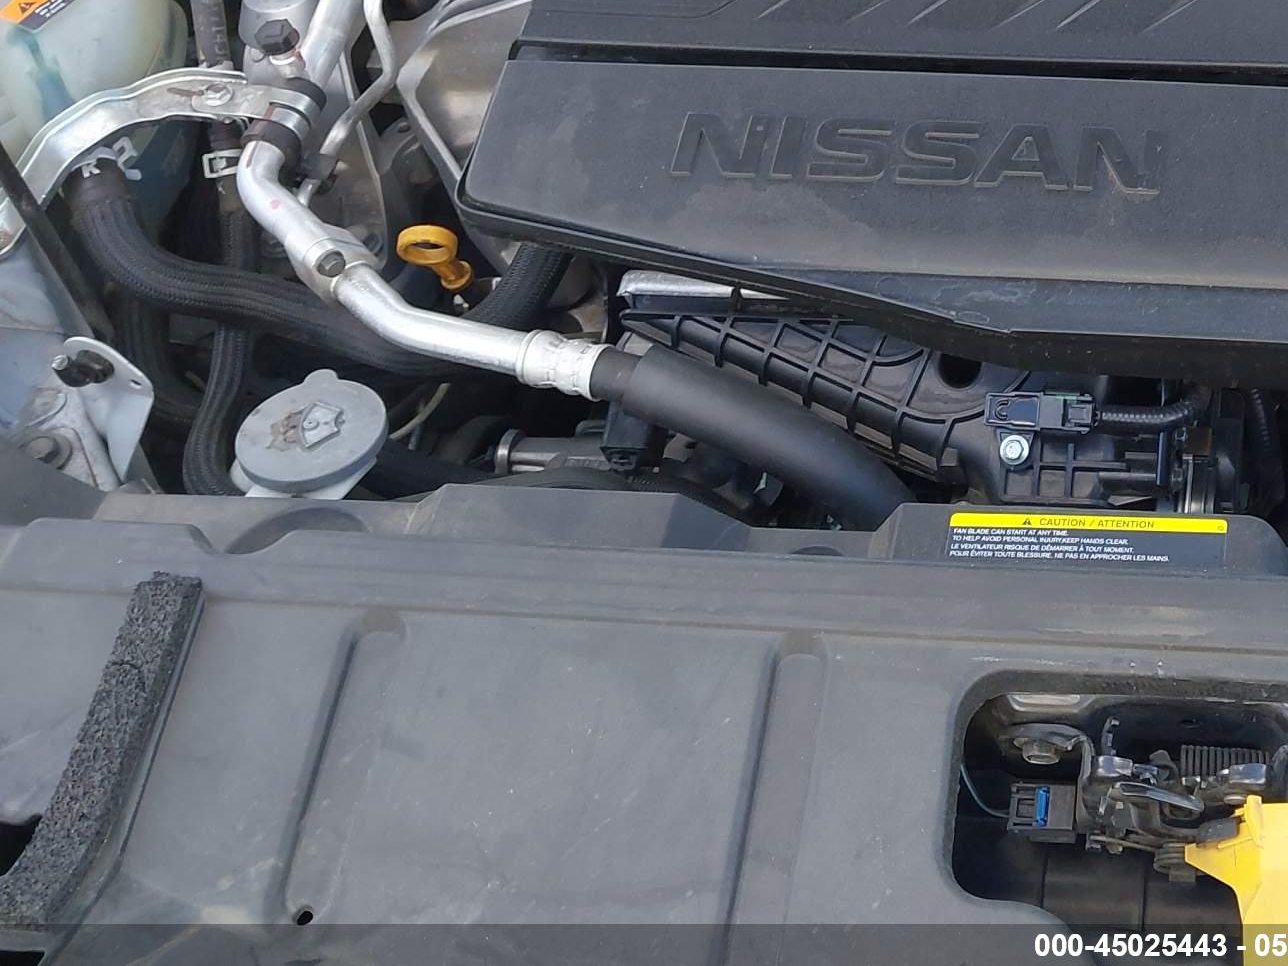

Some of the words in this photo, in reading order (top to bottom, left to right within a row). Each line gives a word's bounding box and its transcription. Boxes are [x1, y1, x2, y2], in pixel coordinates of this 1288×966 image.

[669, 112, 1168, 195] NISSAN
[1039, 518, 1086, 527] CAUTION
[1097, 520, 1155, 529] ATTENTION
[1004, 543, 1029, 551] RISQUE
[1041, 543, 1078, 552] DÉMARRER
[1078, 544, 1084, 552] À
[969, 549, 993, 557] ÉVITER
[1089, 553, 1132, 561] APPROCHER
